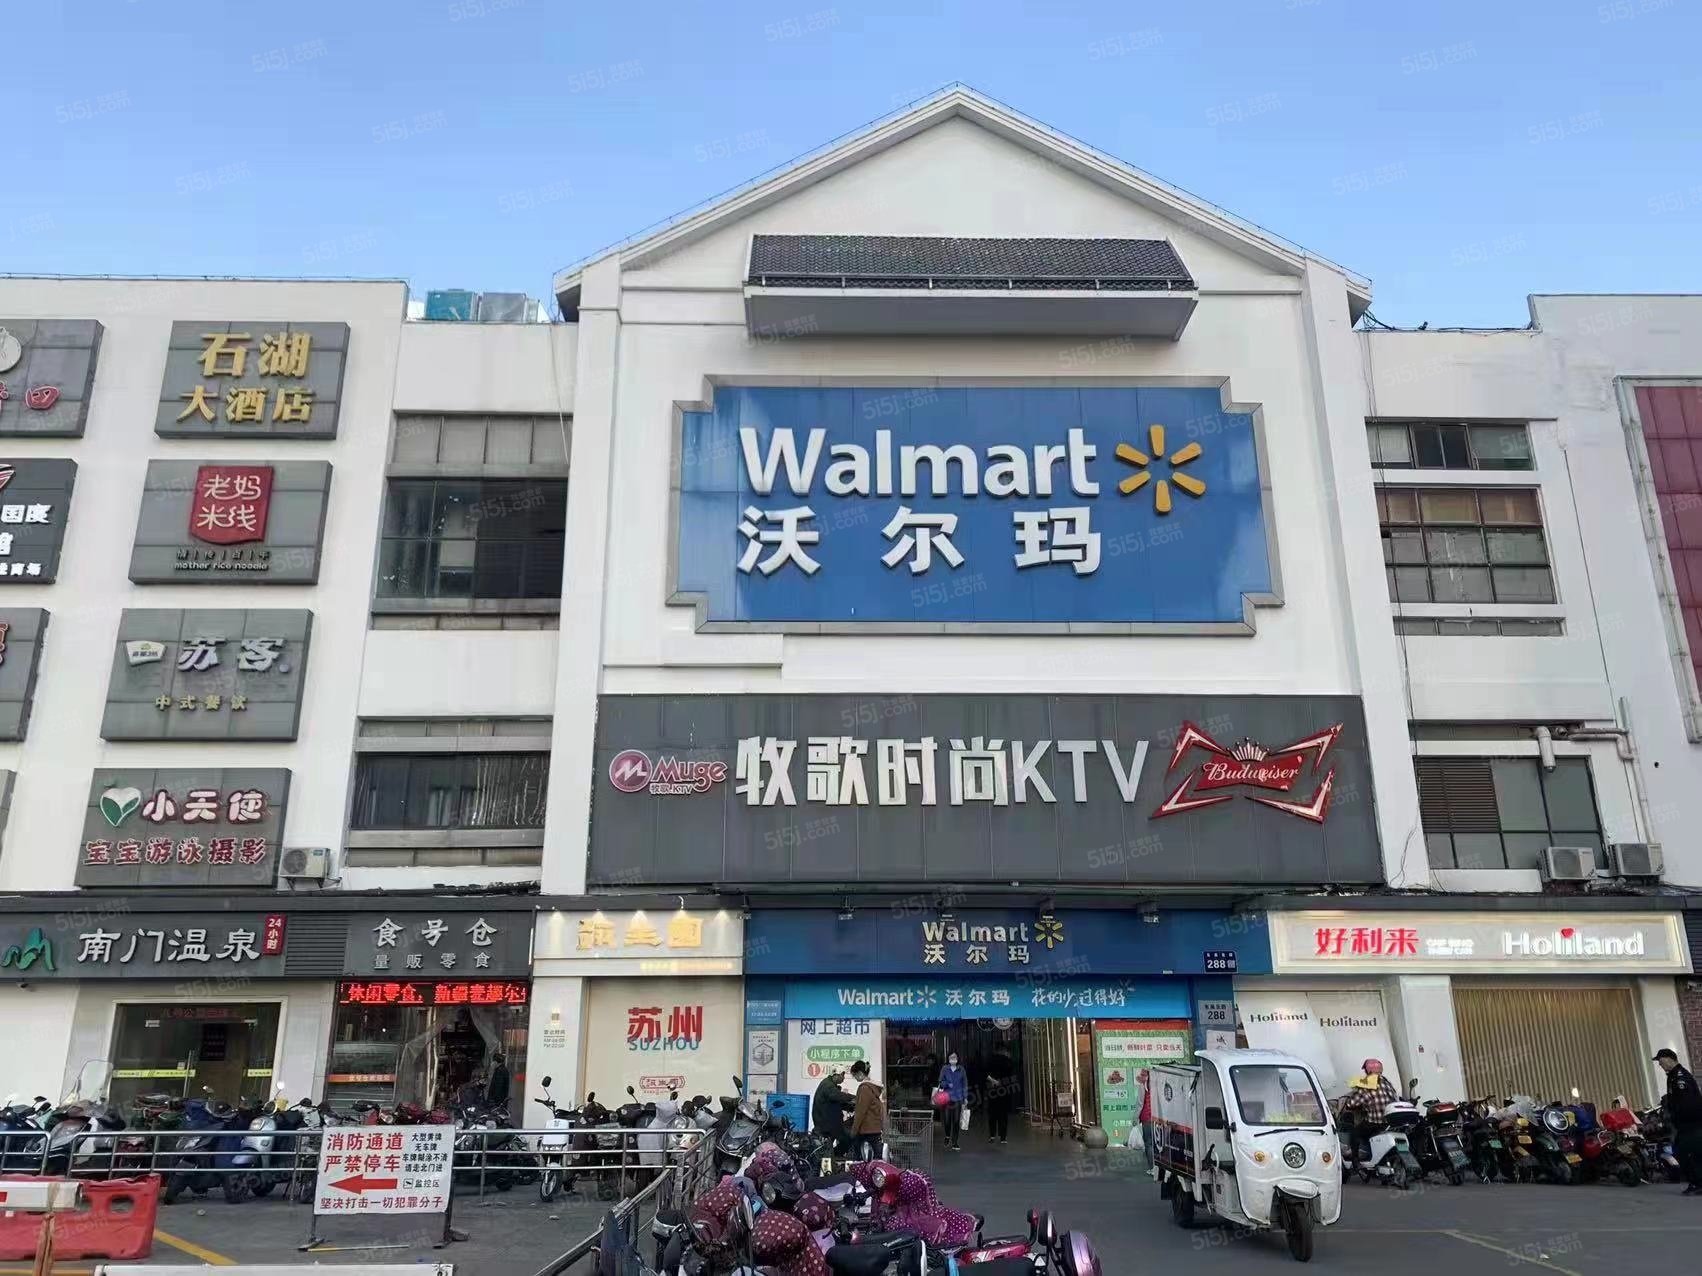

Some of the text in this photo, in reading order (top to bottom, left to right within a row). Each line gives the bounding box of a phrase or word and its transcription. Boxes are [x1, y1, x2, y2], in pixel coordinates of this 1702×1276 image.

[199, 332, 312, 378] 石湖
[177, 385, 314, 423] 大酒店
[739, 427, 1100, 497] Walmart
[203, 474, 261, 500] 老妈
[197, 504, 257, 532] 米线
[736, 505, 1101, 575] 沃尔玛
[177, 636, 286, 671] 苏客
[650, 756, 728, 792] Muge
[736, 736, 1150, 806] 牧歌时尚KTV
[1203, 763, 1299, 782] Budweiser
[141, 789, 266, 824] 小天使
[83, 837, 266, 865] 宝宝游泳摄影
[372, 917, 498, 947] 食号仓
[922, 921, 1029, 943] Walmart
[1315, 928, 1419, 956] 好利来
[1504, 929, 1645, 956] Holiland
[77, 928, 260, 963] 南门温泉
[923, 944, 1030, 965] 沃尔玛
[374, 952, 491, 970] 量贩零食
[837, 988, 913, 1006] Walmart
[945, 989, 1010, 1006] 沃尔玛
[627, 1005, 704, 1043] 苏州
[1208, 1011, 1225, 1020] 288
[1250, 1012, 1308, 1023] Holiland
[1320, 1016, 1377, 1027] Holiland
[800, 1018, 870, 1036] 网上超市
[628, 1037, 701, 1051] SUZHOU
[810, 1048, 860, 1059] 小程序下单
[327, 1132, 404, 1151] 消防通道
[414, 1143, 437, 1151] 无车牌
[324, 1155, 401, 1173] 严禁停车
[414, 1179, 440, 1188] 监控区
[320, 1196, 444, 1209] 坚决打击一切犯罪分子
